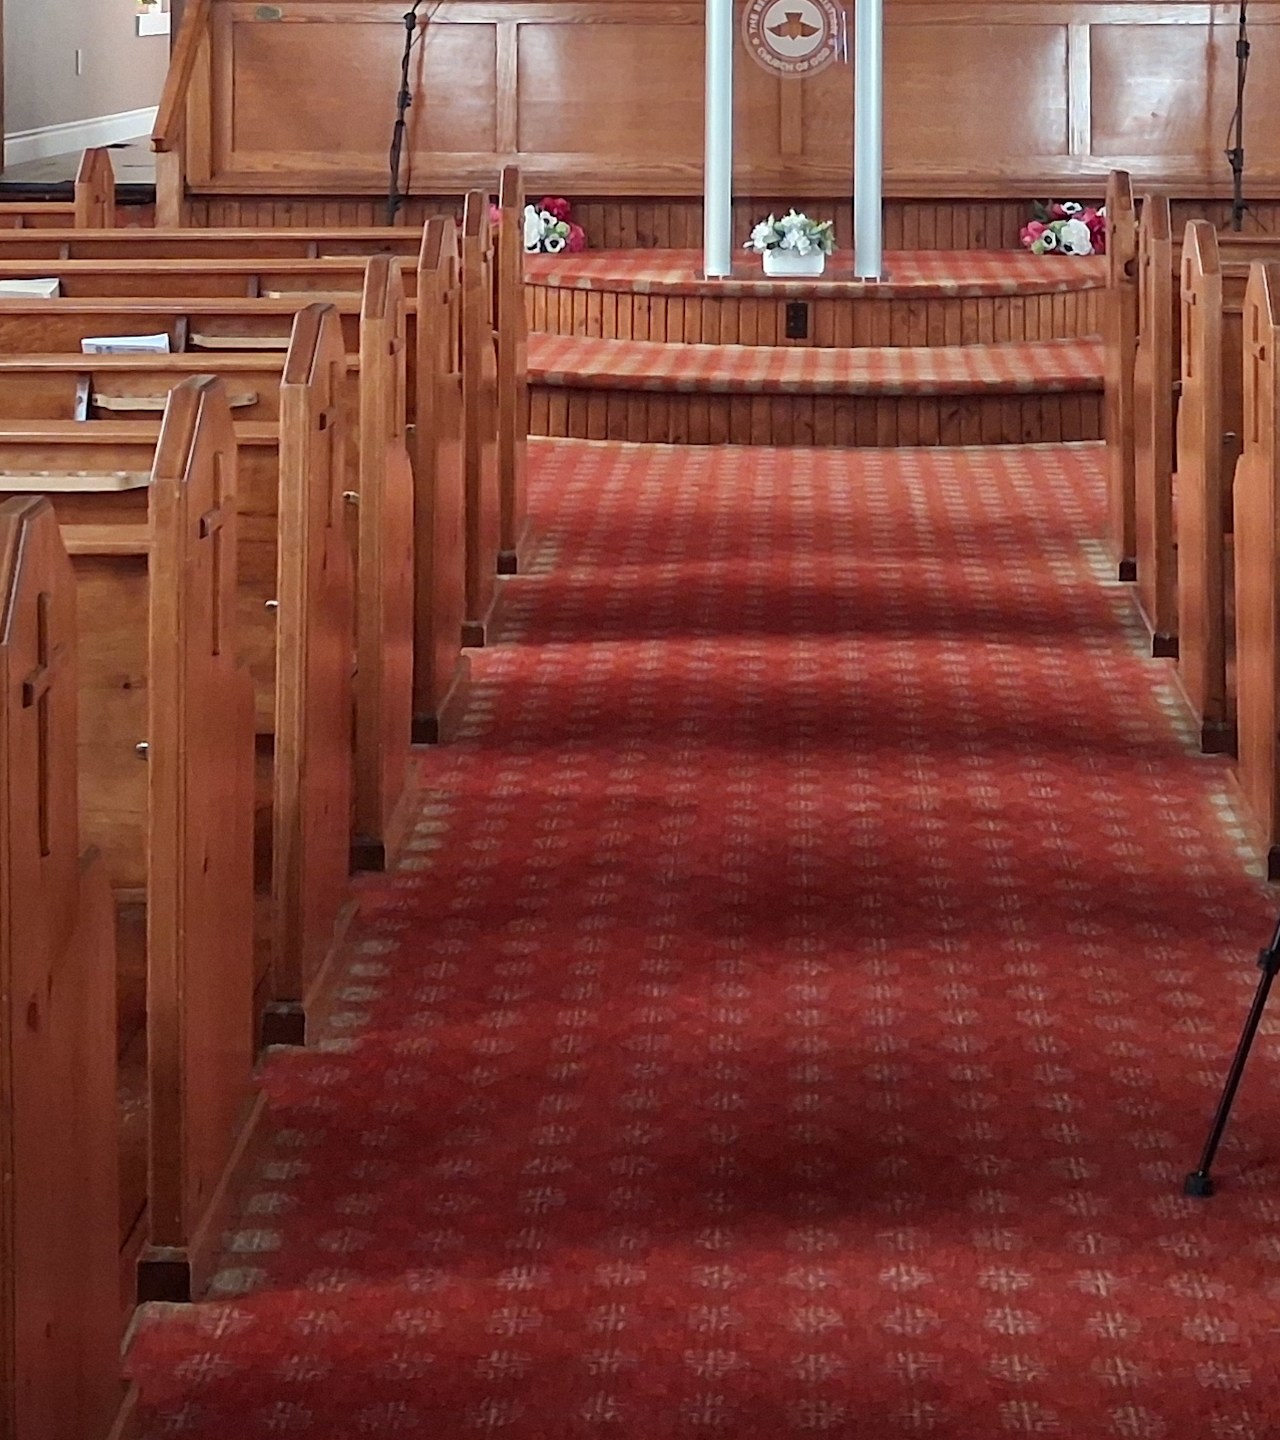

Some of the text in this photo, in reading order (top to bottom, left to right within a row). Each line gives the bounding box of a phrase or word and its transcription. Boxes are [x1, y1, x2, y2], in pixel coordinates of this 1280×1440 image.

[749, 13, 759, 34] THE
[757, 47, 830, 71] CHURCH OF GOD
